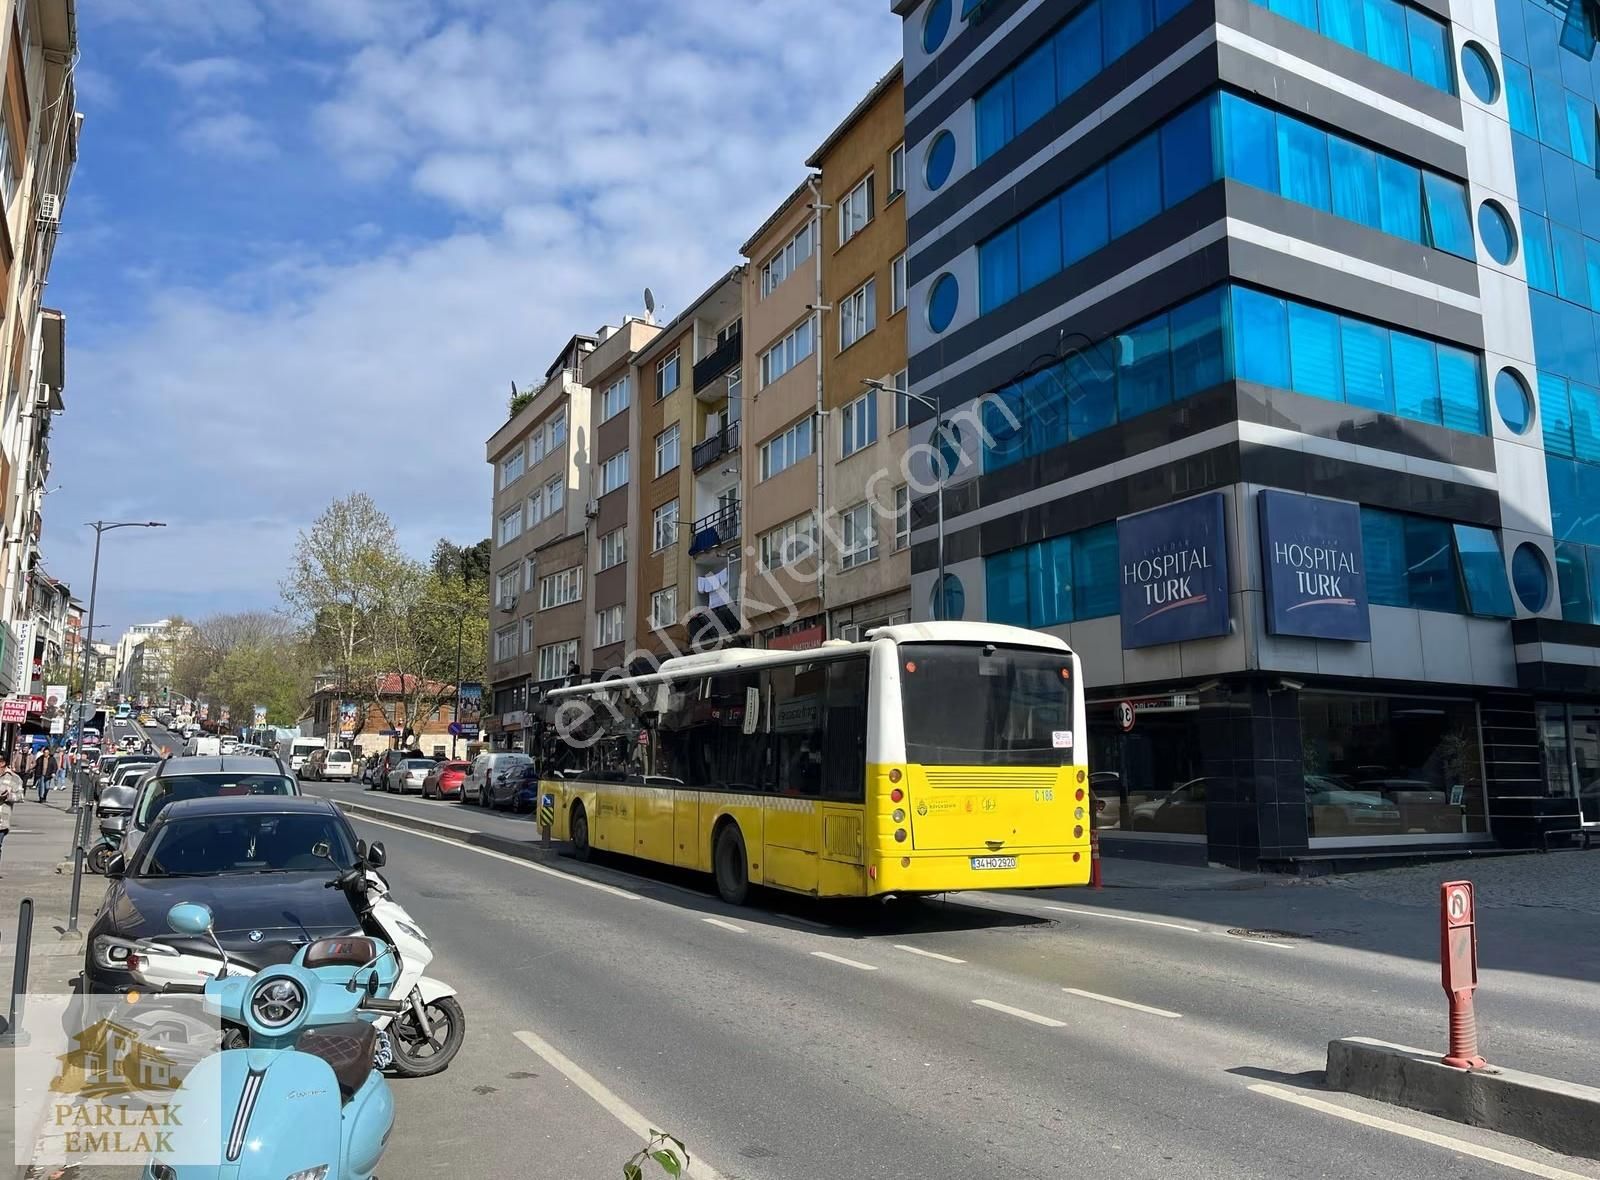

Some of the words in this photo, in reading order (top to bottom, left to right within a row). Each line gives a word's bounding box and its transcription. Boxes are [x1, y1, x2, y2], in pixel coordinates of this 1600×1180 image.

[1123, 546, 1213, 585] HOSPITAL
[1275, 541, 1360, 575] HOSPITAL
[1143, 575, 1193, 606] TURK
[1295, 570, 1343, 598] TURK
[975, 858, 985, 868] 34
[985, 858, 998, 868] HO
[997, 857, 1016, 868] 2920
